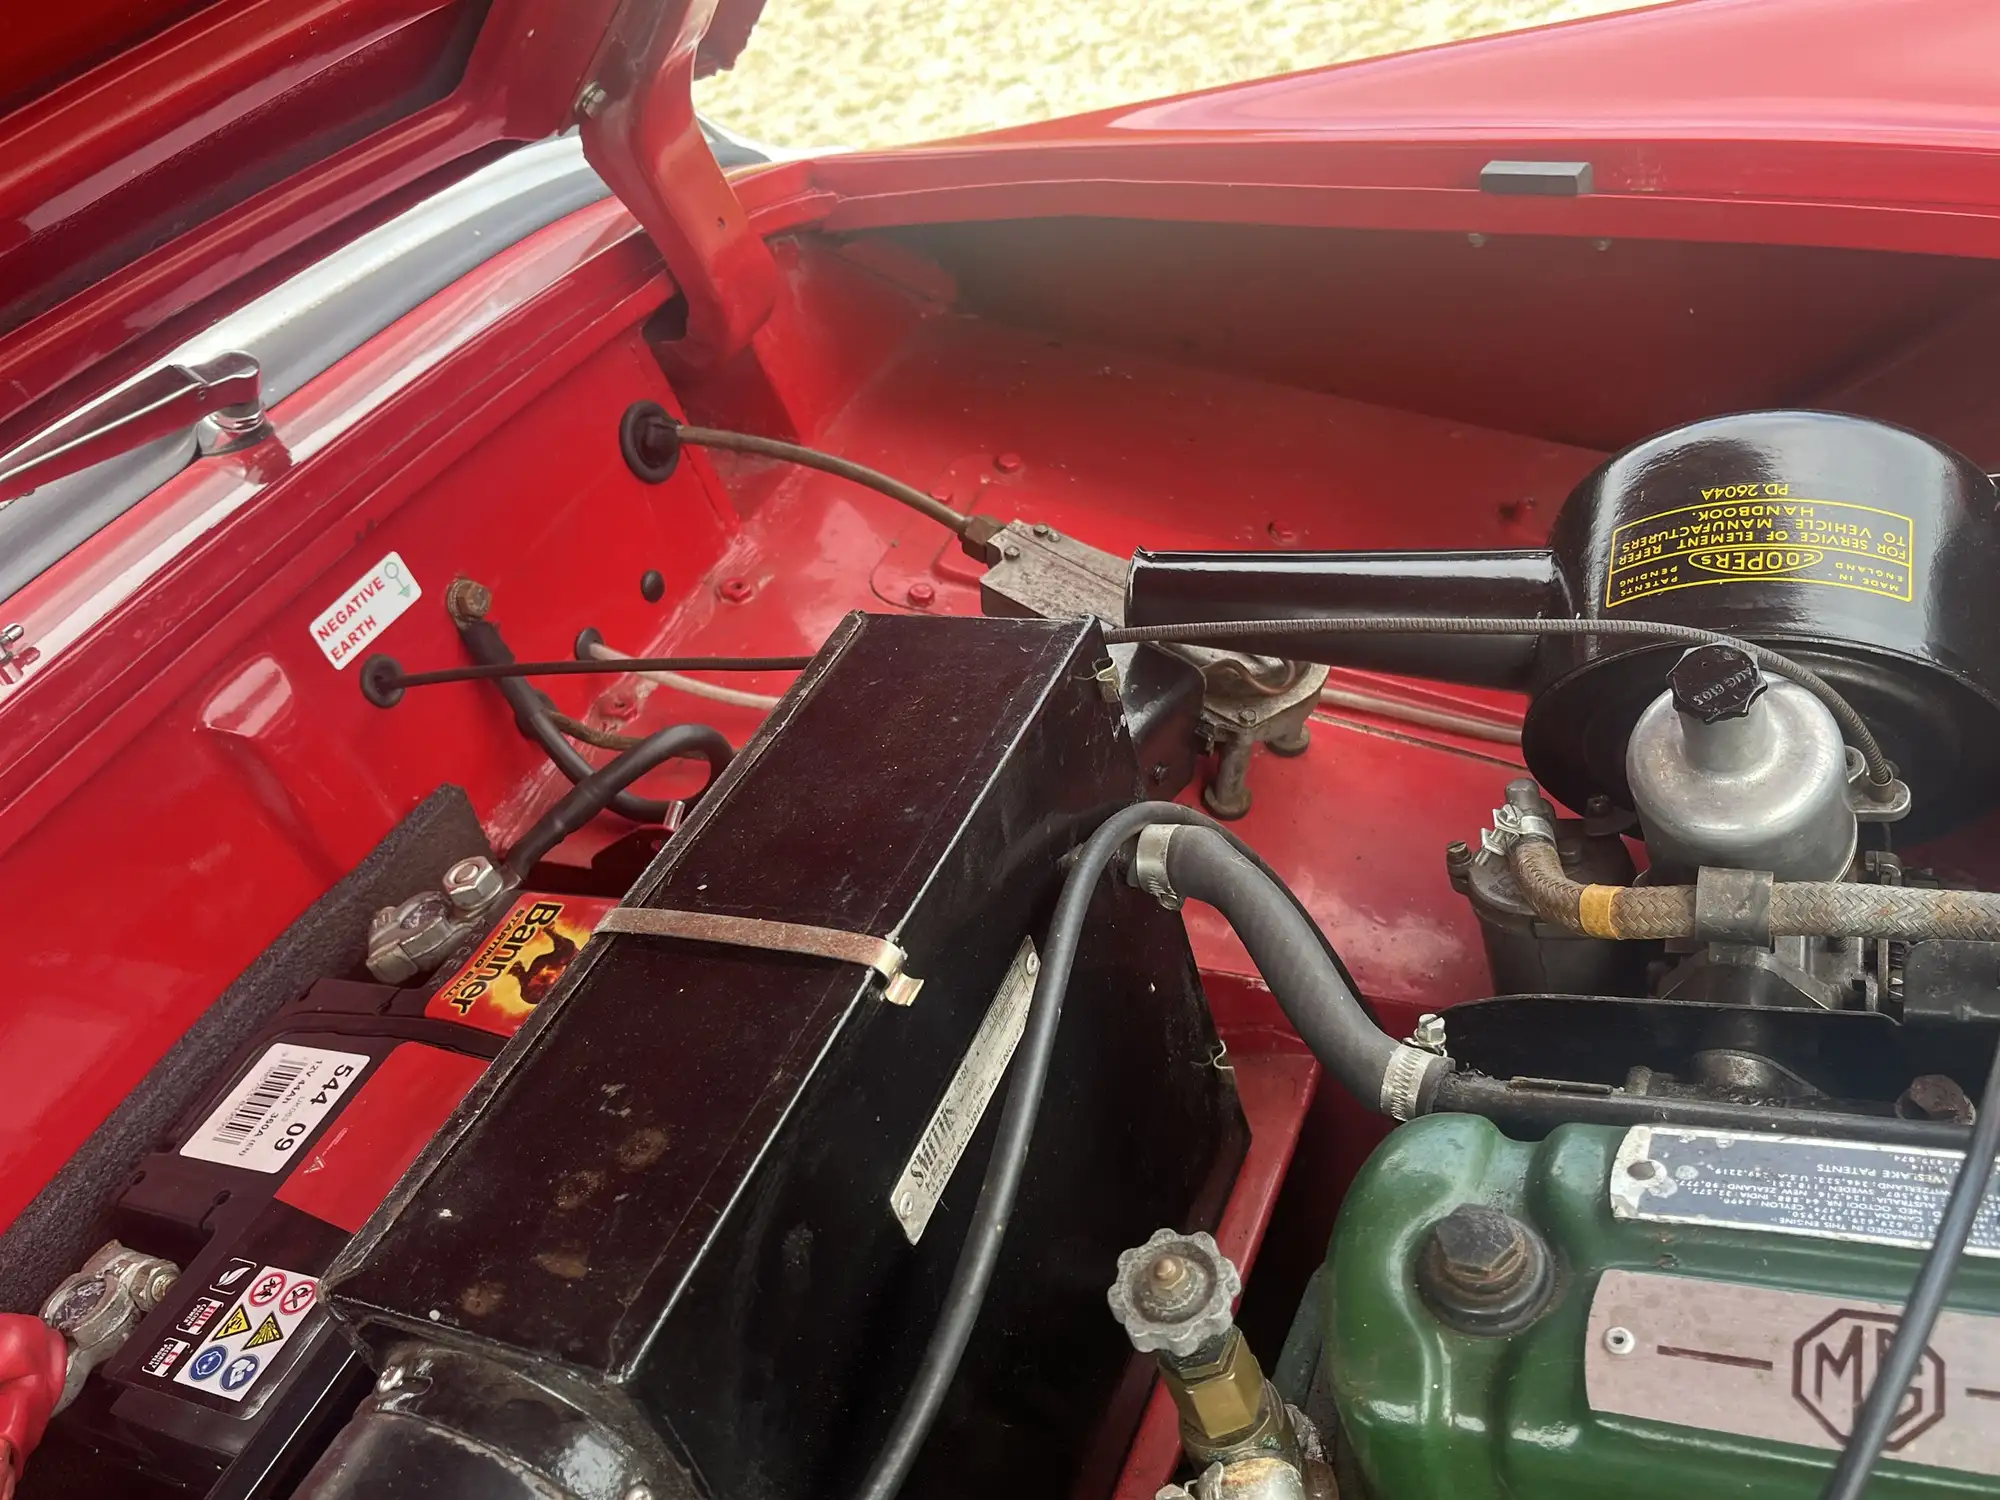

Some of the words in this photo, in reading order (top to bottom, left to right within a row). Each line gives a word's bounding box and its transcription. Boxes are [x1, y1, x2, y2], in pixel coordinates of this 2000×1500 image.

[1622, 518, 1772, 552] MANUFACTURERS
[1766, 531, 1788, 541] OF
[1795, 519, 1871, 538] VEHICLE
[1677, 531, 1753, 549] ELEMENT
[1800, 532, 1868, 549] SERVICE
[1884, 532, 1905, 546] TO
[1619, 544, 1661, 565] REFER
[1876, 543, 1906, 560] FOR
[1619, 565, 1677, 587] PENDING
[1835, 562, 1903, 582] ENGLAND
[1839, 574, 1853, 582] IN
[1620, 576, 1678, 596] PATENTS
[1862, 578, 1899, 592] MADE
[317, 576, 386, 641] NEGATIVE
[330, 615, 377, 661] EARTH
[475, 909, 525, 967] STARTING
[451, 903, 563, 1014] Banner
[444, 971, 474, 999] BULL
[306, 1060, 323, 1077] 12V
[310, 1064, 354, 1105] 544
[255, 1112, 279, 1136] 360A
[274, 1123, 306, 1151] 09
[910, 1096, 957, 1188] SMITHS
[1816, 1164, 1877, 1177] PATENTS
[1882, 1169, 1945, 1184] WESLAKE
[1780, 1189, 1808, 1197] NEW
[192, 1306, 216, 1327] FULL
